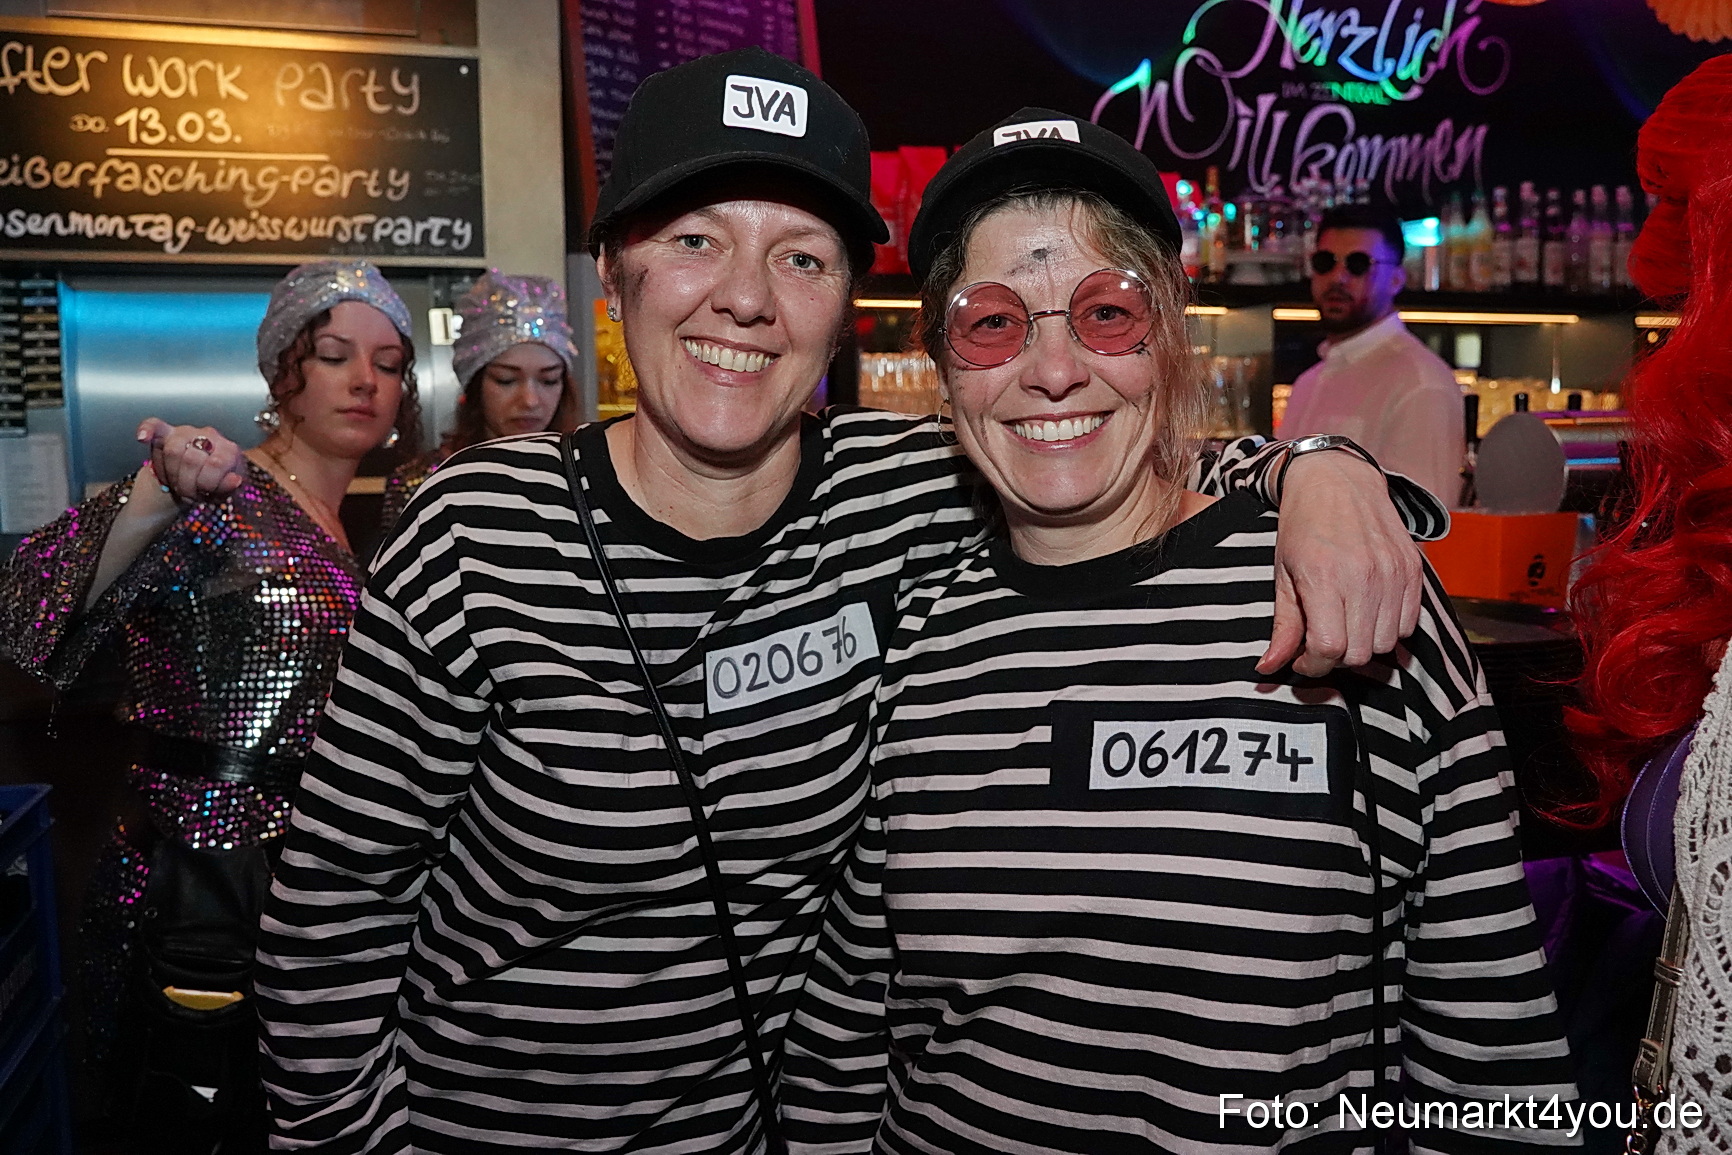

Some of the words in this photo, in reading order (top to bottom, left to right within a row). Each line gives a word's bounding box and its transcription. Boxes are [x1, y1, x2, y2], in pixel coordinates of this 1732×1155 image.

[114, 107, 242, 145] 13.03.
[730, 84, 797, 126] JVA
[712, 615, 858, 700] 020676
[1102, 727, 1314, 782] 061274
